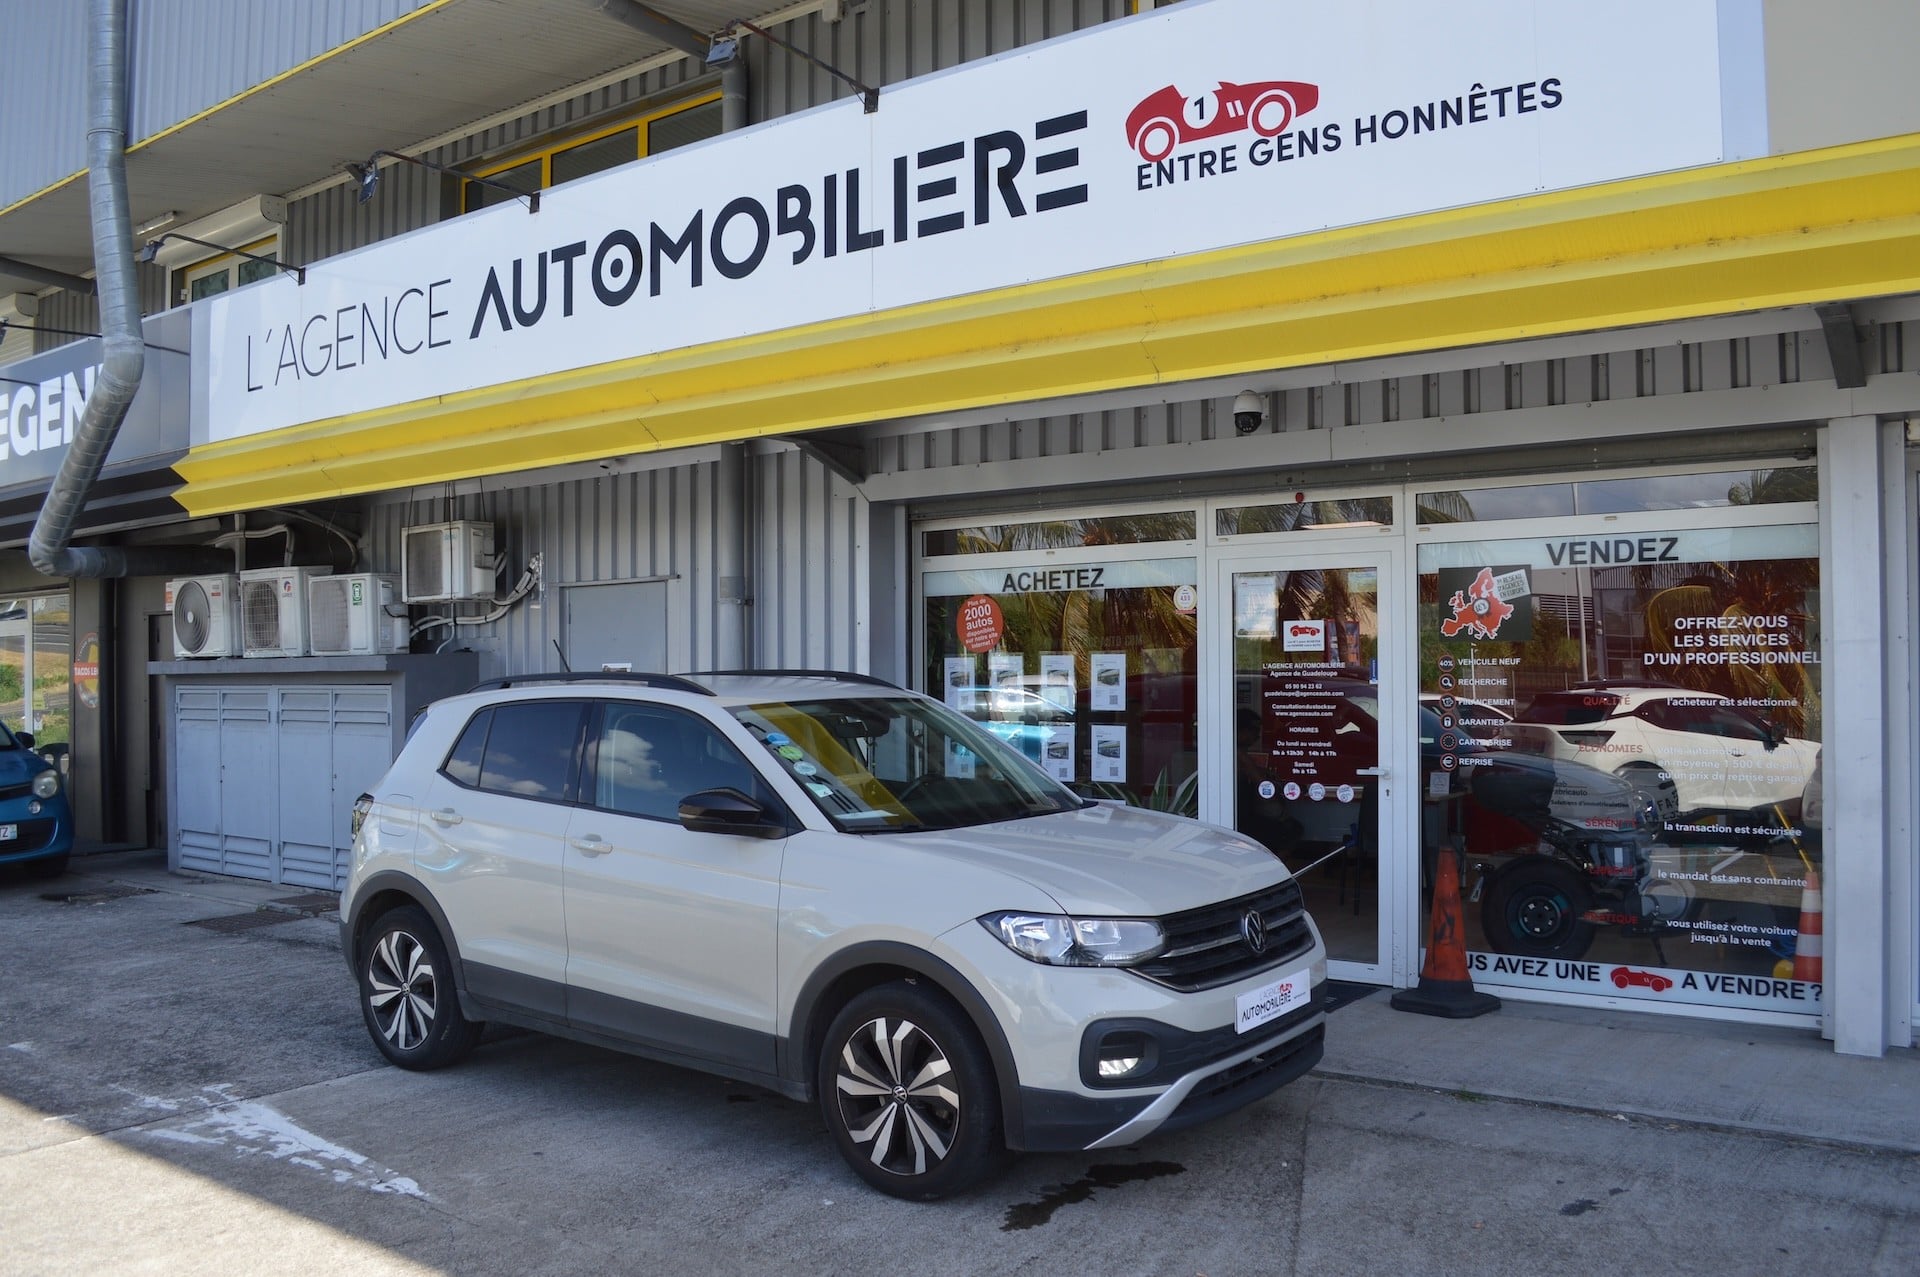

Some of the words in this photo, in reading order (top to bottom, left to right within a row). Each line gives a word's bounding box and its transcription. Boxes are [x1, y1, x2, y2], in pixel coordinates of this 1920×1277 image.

[1138, 145, 1237, 190] ENTRE
[1249, 124, 1341, 166] GENS
[1355, 78, 1563, 145] HONNÊTES
[247, 279, 451, 392] L'AGENCE
[1547, 537, 1680, 567] VENDEZ
[1002, 568, 1104, 592] ACHETEZ
[964, 604, 992, 621] 2000
[966, 617, 994, 630] autos
[1674, 615, 1788, 630] OFFREZ-VOUS
[1674, 635, 1704, 648] LES
[1708, 633, 1789, 647] SERVICES
[1644, 653, 1681, 665] D'UN
[1685, 651, 1821, 665] PROFESSIONNEL
[1667, 697, 1717, 707] l'acheteur
[1719, 698, 1735, 707] est
[1736, 697, 1798, 707] sélectionné
[1459, 758, 1493, 766] REPRISE
[1689, 773, 1709, 783] prix
[1664, 821, 1674, 831] la
[1675, 823, 1732, 834] transaction
[1734, 825, 1750, 835] est
[1751, 824, 1802, 837] sécurisée
[1657, 869, 1668, 879] le
[1669, 870, 1708, 881] mandat
[1710, 873, 1727, 883] est
[1729, 874, 1752, 884] sans
[1753, 874, 1808, 888] contrainte
[1666, 919, 1691, 929] vous
[1692, 919, 1729, 932] utilisez
[1730, 923, 1758, 934] votre
[1760, 924, 1798, 937] voiture
[1729, 934, 1740, 945] la
[1741, 937, 1772, 948] vente
[1493, 957, 1549, 978] AVEZ
[1555, 962, 1601, 982] UNE
[1682, 973, 1698, 990] A
[1704, 974, 1806, 1000] VENDRE
